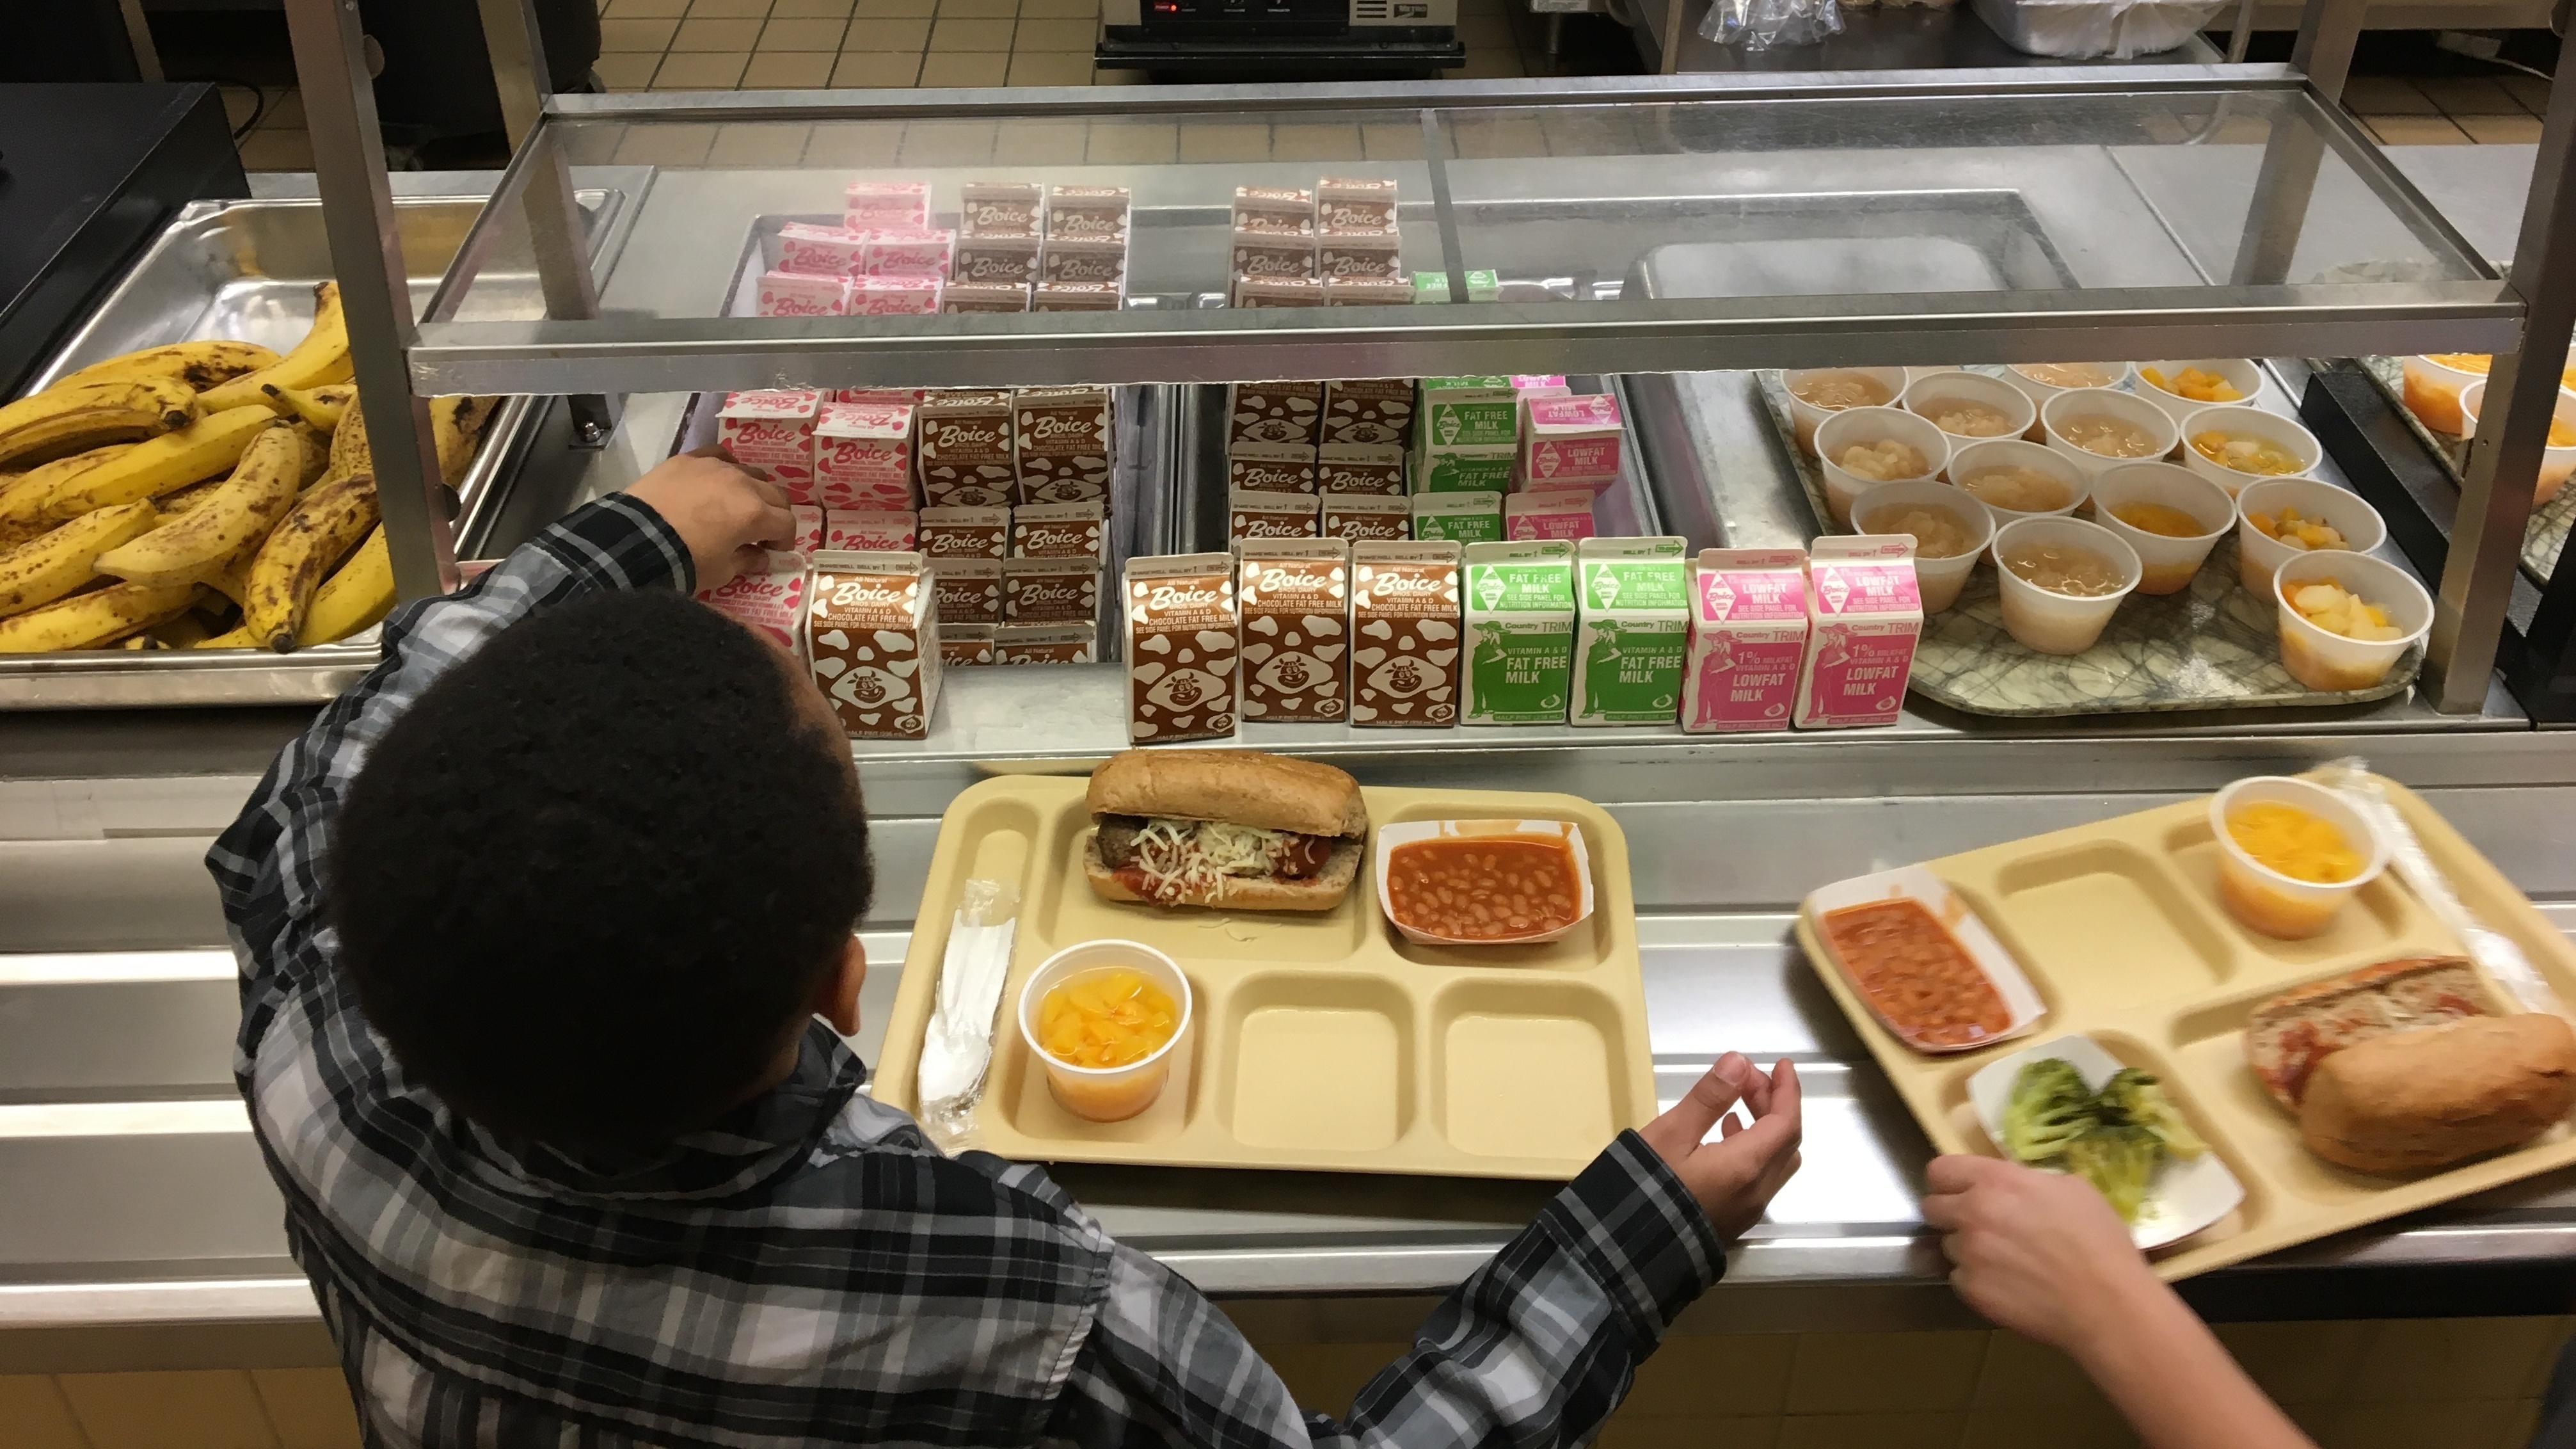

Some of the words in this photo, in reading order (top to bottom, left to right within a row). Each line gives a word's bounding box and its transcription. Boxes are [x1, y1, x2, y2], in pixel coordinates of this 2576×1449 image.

[977, 206, 1028, 225] Boice
[1331, 208, 1381, 226] Boice
[1065, 214, 1114, 232] Boice
[883, 251, 935, 268] Boice
[971, 257, 1024, 276] Boice
[1247, 255, 1299, 274] Boice
[1334, 257, 1385, 275] Boice
[1060, 259, 1113, 279] Boice
[774, 298, 827, 316] Boice
[867, 298, 921, 315] Boice
[1465, 412, 1480, 420] FAT
[1485, 411, 1507, 420] FREE
[1033, 416, 1092, 438] Boice
[1475, 421, 1498, 429] MILK
[736, 422, 796, 444] Boice
[937, 425, 996, 447] Boice
[834, 442, 893, 463] Boice
[1568, 448, 1605, 457] LOWFAT
[1575, 456, 1598, 465] MILK
[1244, 468, 1298, 486] Boice
[1330, 472, 1385, 490] Boice
[1247, 520, 1303, 538] Boice
[1340, 521, 1395, 540] Boice
[1468, 520, 1490, 529] FREE
[1543, 521, 1579, 530] LOWFAT
[1027, 529, 1083, 550] Boice
[1458, 529, 1481, 538] MILK
[844, 534, 900, 550] Boice
[931, 534, 989, 553] Boice
[1259, 568, 1327, 592] Boice
[1509, 574, 1529, 583] FAT
[1533, 573, 1562, 583] FREE
[1623, 572, 1643, 581] FAT
[1647, 572, 1676, 581] FREE
[1856, 575, 1899, 586] LOWFAT
[716, 577, 783, 597] Boice
[1373, 572, 1442, 596] Boice
[1522, 584, 1550, 593] MILK
[1636, 582, 1665, 592] MILK
[1742, 583, 1787, 594] LOWFAT
[1866, 586, 1894, 596] MILK
[832, 582, 902, 605] Boice
[1020, 584, 1078, 605] Boice
[1150, 586, 1218, 611] Boice
[1709, 591, 1735, 602] Boice
[1752, 594, 1781, 604] MILK
[1371, 604, 1408, 612] CHOCOLATE
[827, 613, 865, 621] CHOCOLATE
[1149, 616, 1187, 626] CHOCOLATE
[1505, 622, 1539, 630] Country
[1541, 621, 1572, 632] TRIM
[1621, 621, 1655, 629] Country
[1657, 620, 1689, 632] TRIM
[1888, 622, 1919, 634] TRIM
[1737, 631, 1770, 639] Country
[1772, 630, 1804, 642] TRIM
[1852, 644, 1875, 657] 1%
[1877, 648, 1907, 657] MILKFAT
[1506, 657, 1530, 670] FAT
[1534, 656, 1567, 669] FREE
[1621, 657, 1645, 670] FAT
[1648, 656, 1682, 669] FREE
[1738, 651, 1761, 665] 1%
[1850, 657, 1884, 666] VITAMIN
[1505, 671, 1540, 684] MILK
[1619, 670, 1654, 683] MILK
[1733, 673, 1786, 687] LOWFAT
[1846, 666, 1899, 680] LOWFAT
[1730, 689, 1764, 701] MILK
[1843, 682, 1877, 696] MILK
